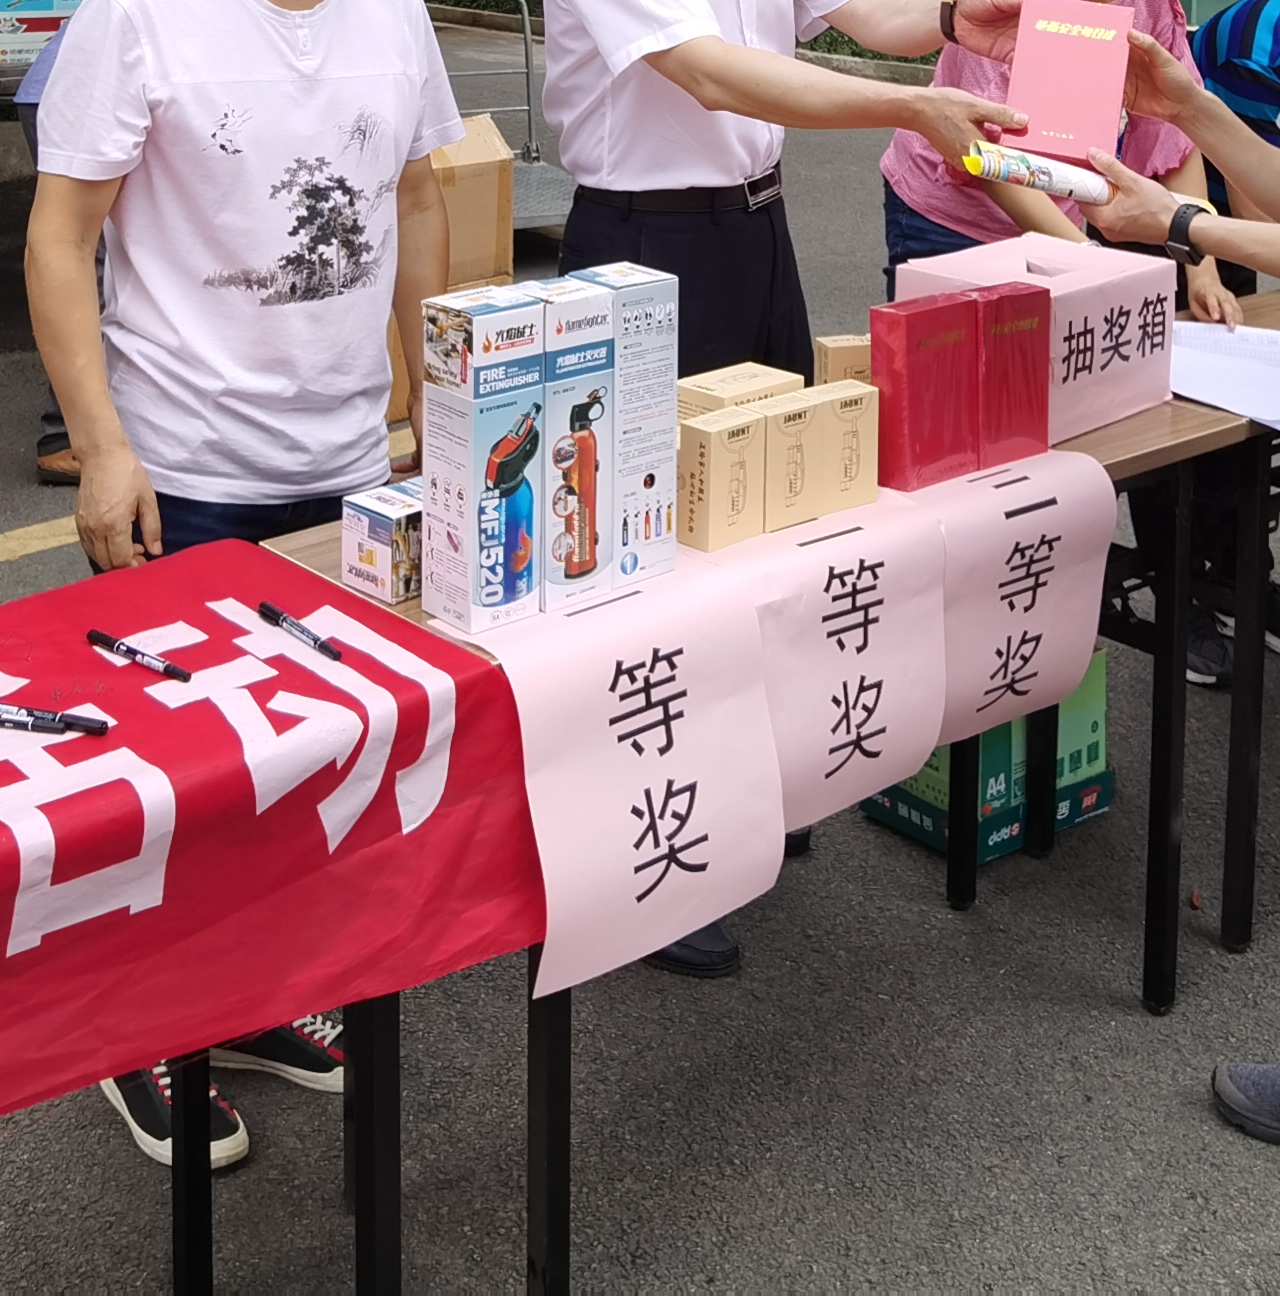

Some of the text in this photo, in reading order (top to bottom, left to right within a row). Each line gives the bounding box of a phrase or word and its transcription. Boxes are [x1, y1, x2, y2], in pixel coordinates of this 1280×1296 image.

[1061, 292, 1168, 385] 抽奖箱
[480, 366, 506, 384] FIRE
[480, 372, 539, 394] EXTINGUISHER
[840, 397, 864, 410] JAUNT
[784, 411, 807, 424] JAUNT
[727, 426, 751, 440] JAUNT
[480, 497, 505, 608] MFJ520
[967, 469, 1062, 715] 三等奖
[986, 772, 1007, 800] A4
